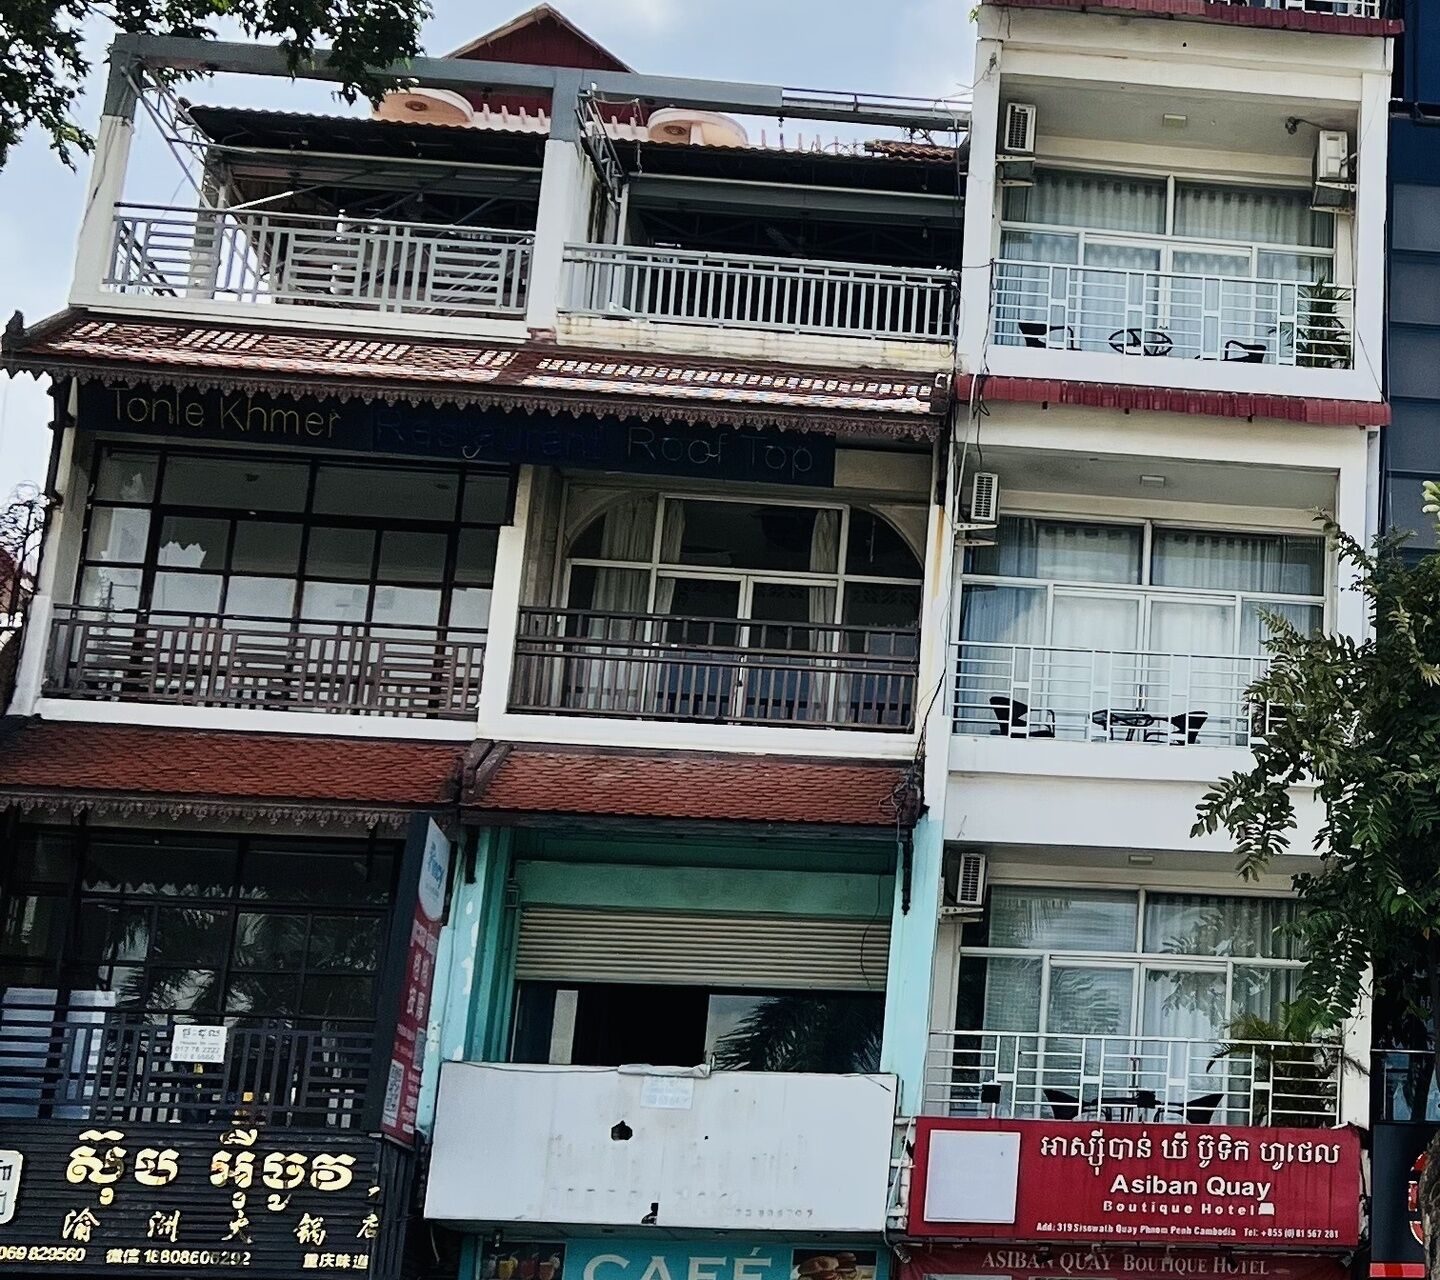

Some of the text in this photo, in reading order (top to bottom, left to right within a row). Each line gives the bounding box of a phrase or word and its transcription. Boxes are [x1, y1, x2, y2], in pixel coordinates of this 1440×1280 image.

[107, 387, 204, 427] Tonle
[220, 395, 341, 438] Khmer
[740, 433, 814, 480] Top
[1110, 1174, 1271, 1201] Asiban Quay
[1103, 1200, 1254, 1216] Boutique Hotel
[1115, 1223, 1138, 1236] Quay
[1140, 1224, 1168, 1234] Phnom
[1170, 1225, 1192, 1235] Penh
[1193, 1226, 1236, 1236] Cambodia
[1060, 1251, 1114, 1274] QUAY
